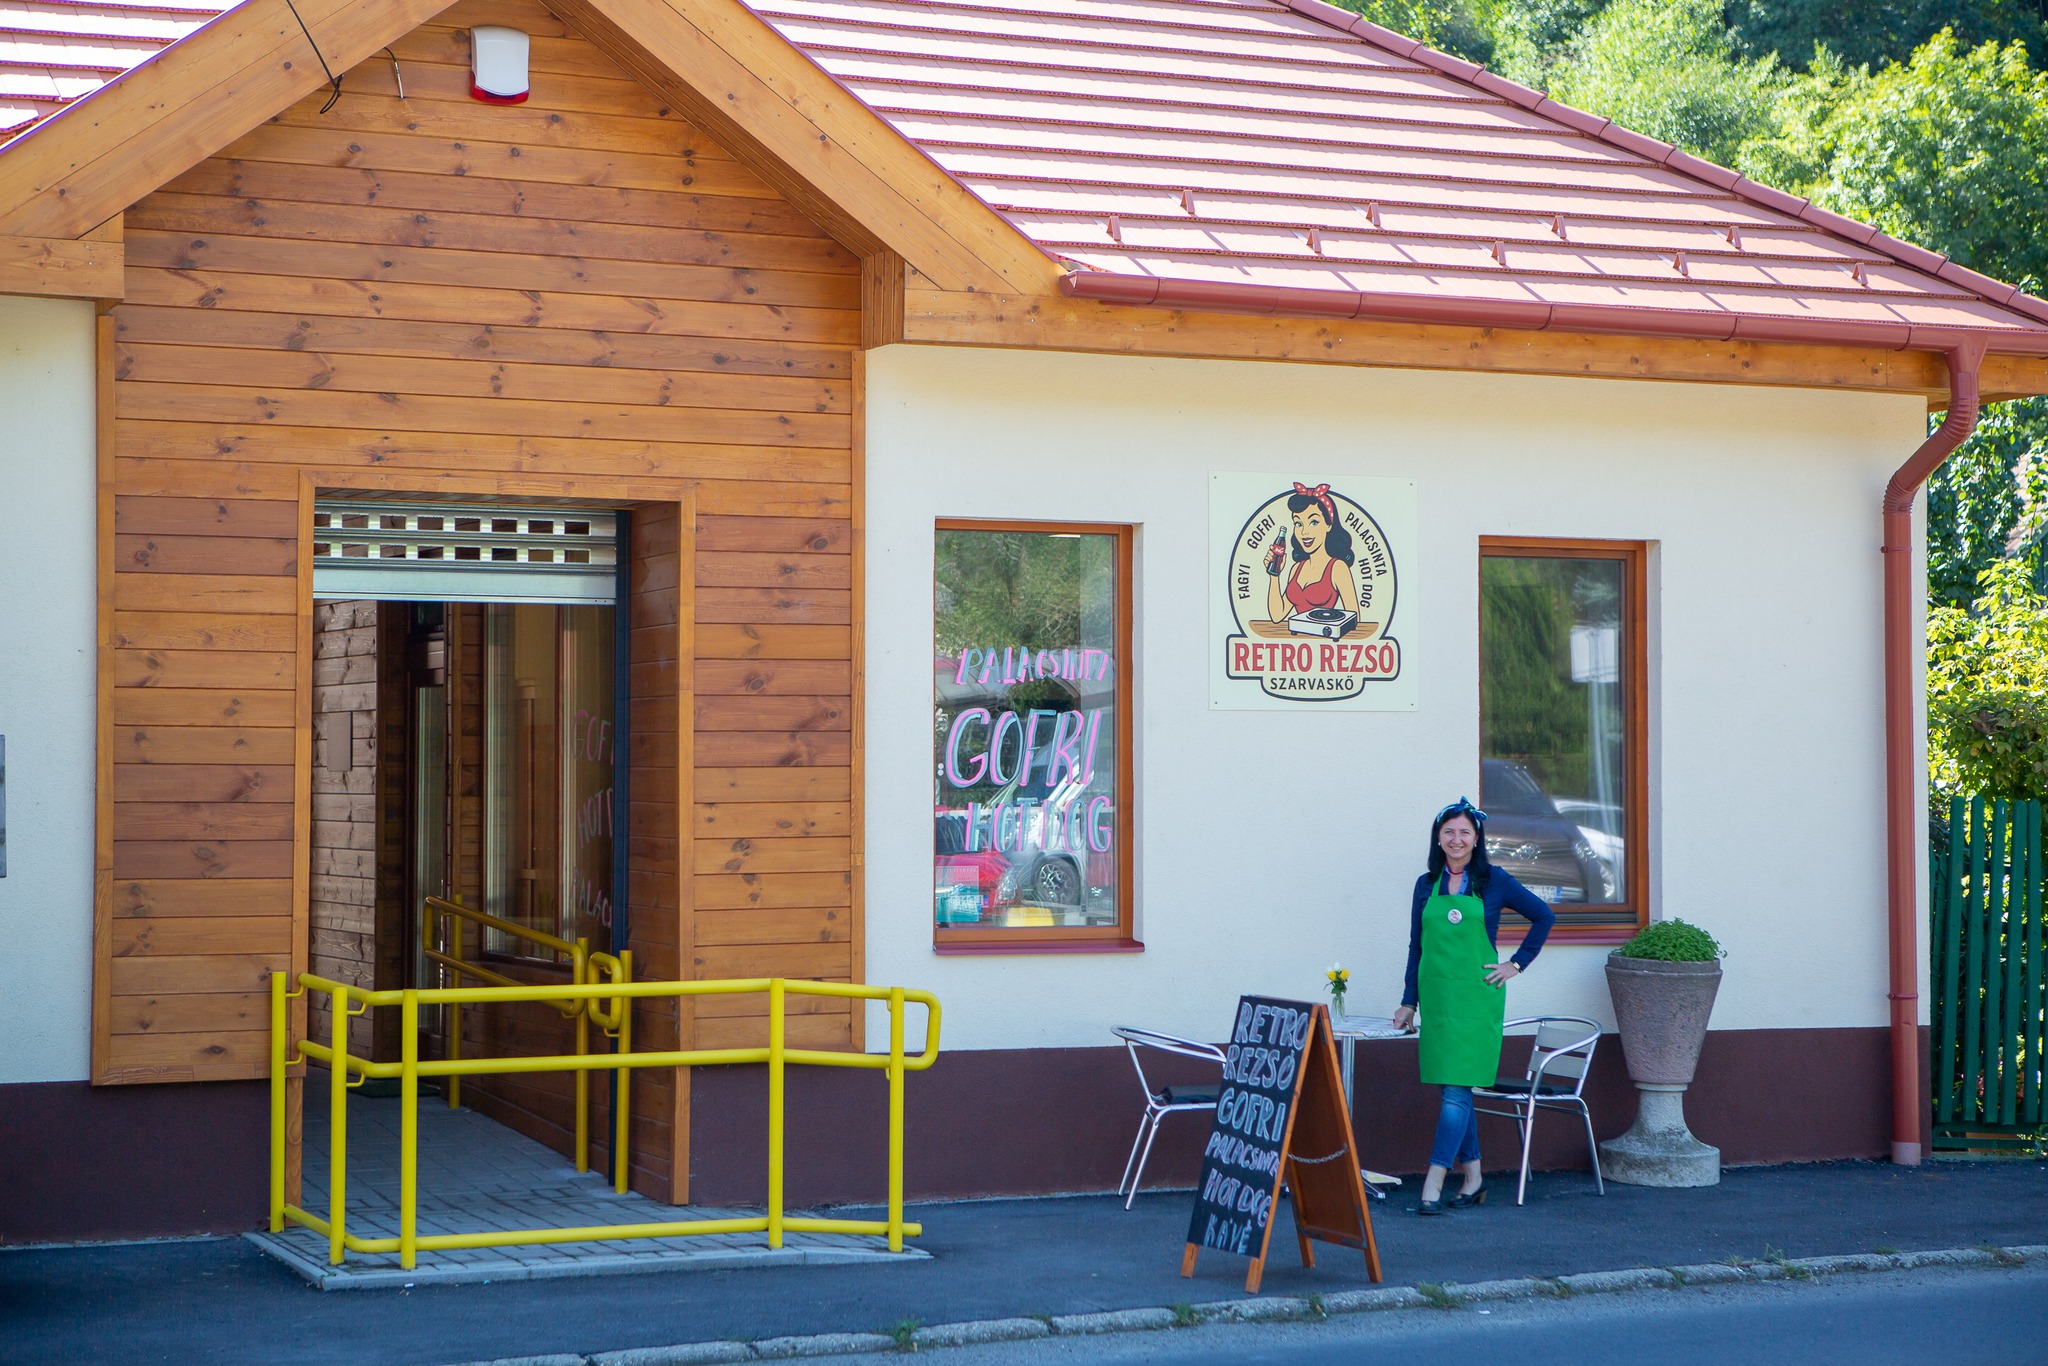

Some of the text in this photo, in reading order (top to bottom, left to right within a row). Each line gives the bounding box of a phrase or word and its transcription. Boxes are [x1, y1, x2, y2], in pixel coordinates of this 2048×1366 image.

[1247, 514, 1276, 549] GOFRI
[1345, 512, 1387, 577] PALACSINTA
[1238, 564, 1251, 600] FAGYI
[1358, 558, 1373, 608] HOT DOG
[955, 646, 1114, 684] PALACSINTA
[1234, 642, 1395, 673] RETRO REZSÓ
[1270, 676, 1354, 690] SZARVASKŐ
[946, 707, 1102, 788] GOFRI
[965, 795, 1112, 852] HOT DOG
[1234, 1002, 1309, 1051] RETRO
[1223, 1044, 1295, 1091] REZSÓ
[1217, 1087, 1286, 1142] GOFRI
[1204, 1131, 1280, 1180] PALACSINTA
[1203, 1168, 1272, 1228] HOT DOG
[1203, 1213, 1253, 1254] KÁVÉ
